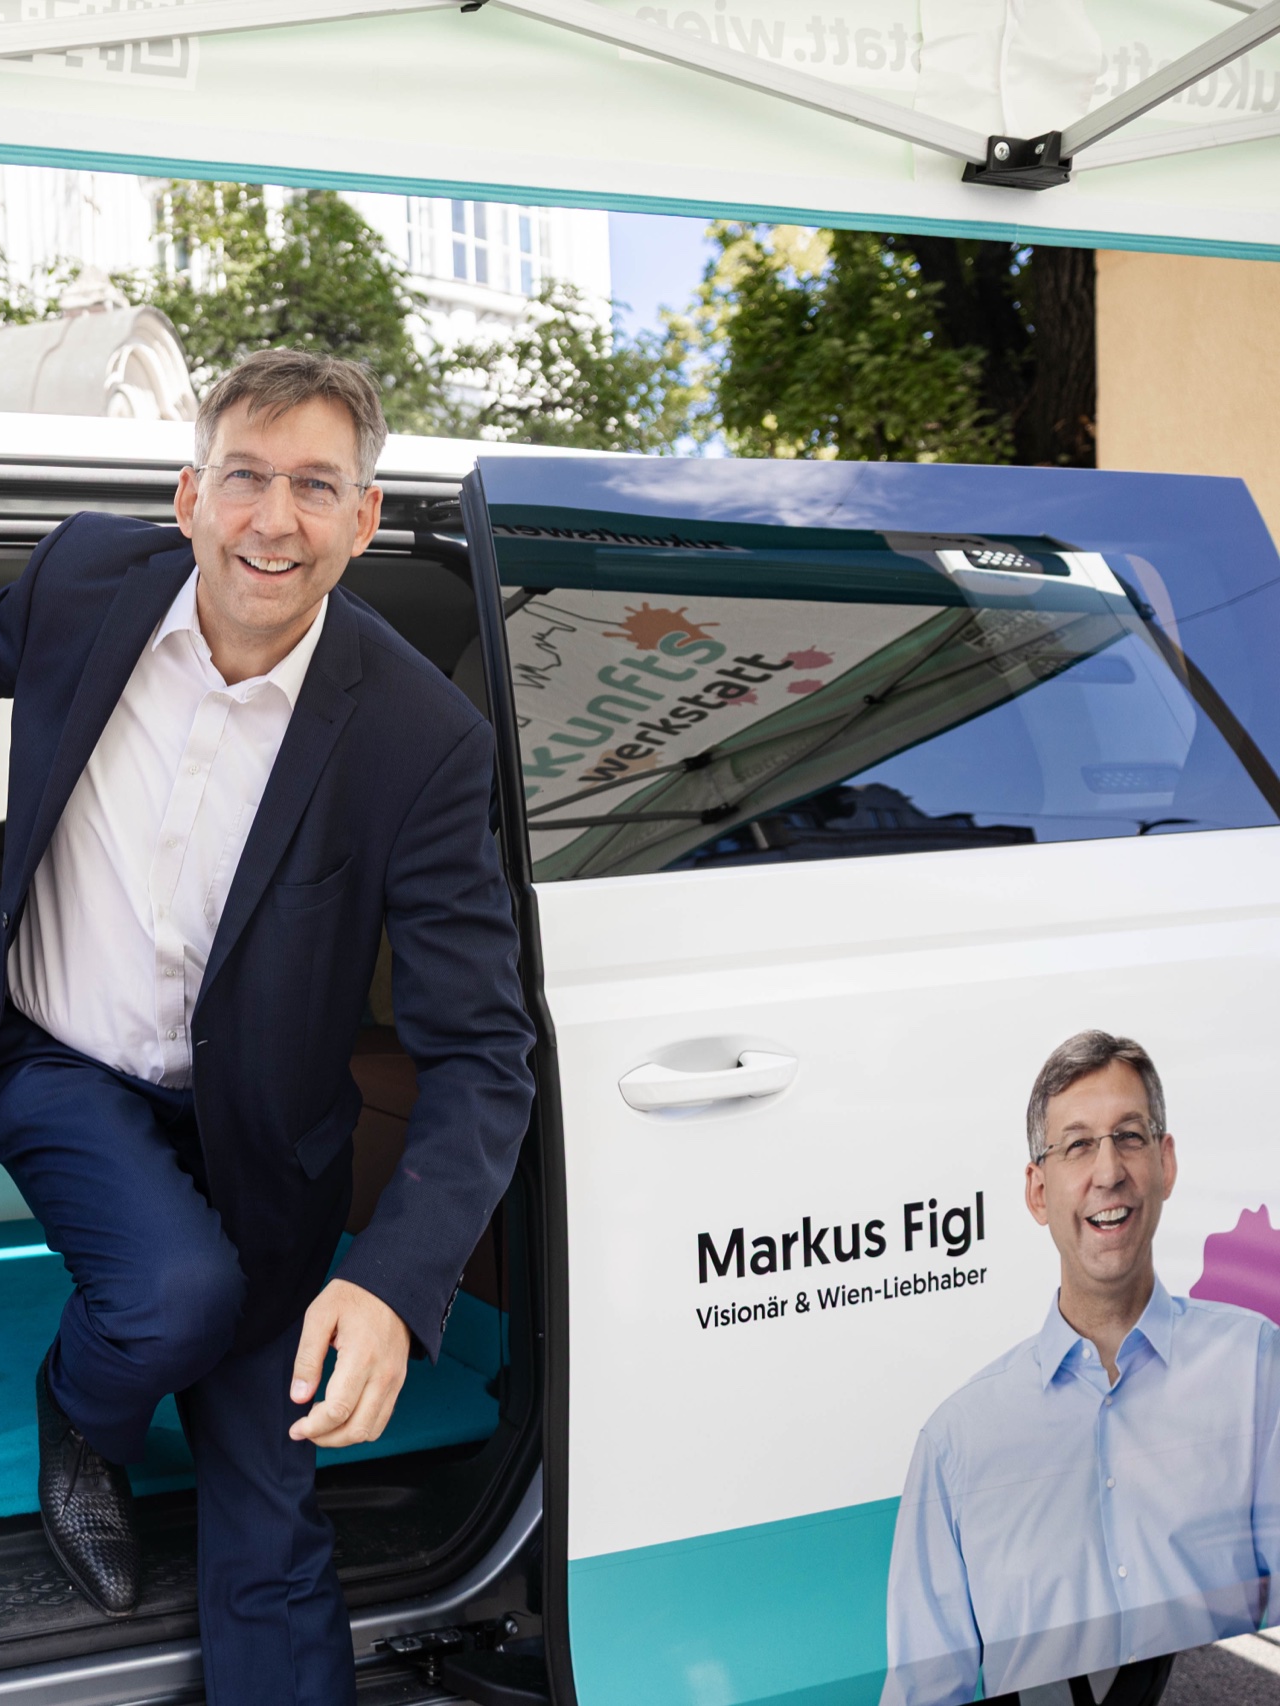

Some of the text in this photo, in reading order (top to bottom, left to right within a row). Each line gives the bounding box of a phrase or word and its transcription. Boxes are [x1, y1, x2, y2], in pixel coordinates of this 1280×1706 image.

[578, 653, 795, 784] werkstatt
[697, 1190, 986, 1284] Markus Figl
[695, 1266, 988, 1330] Visionär & Wien-Liebhaber
